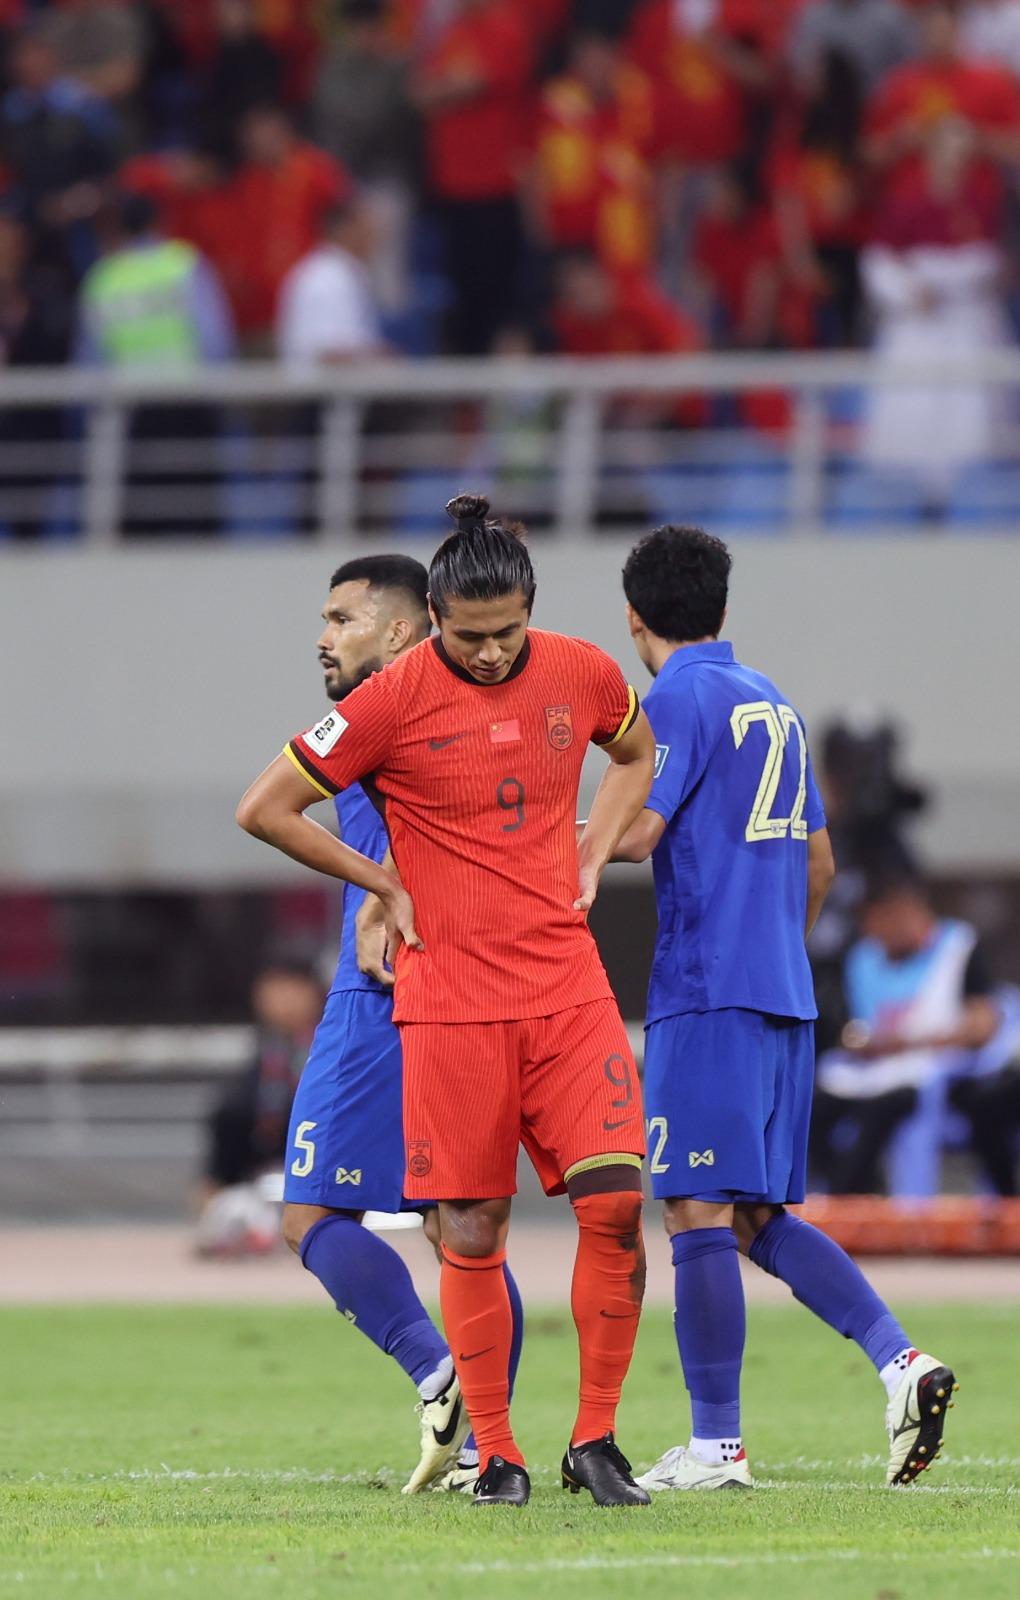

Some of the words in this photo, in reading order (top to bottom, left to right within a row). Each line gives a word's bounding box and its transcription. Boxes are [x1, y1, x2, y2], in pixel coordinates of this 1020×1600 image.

[730, 701, 808, 842] 22
[497, 777, 525, 832] 9
[604, 1053, 632, 1108] 9
[291, 1120, 317, 1177] 5
[646, 1116, 671, 1174] 2
